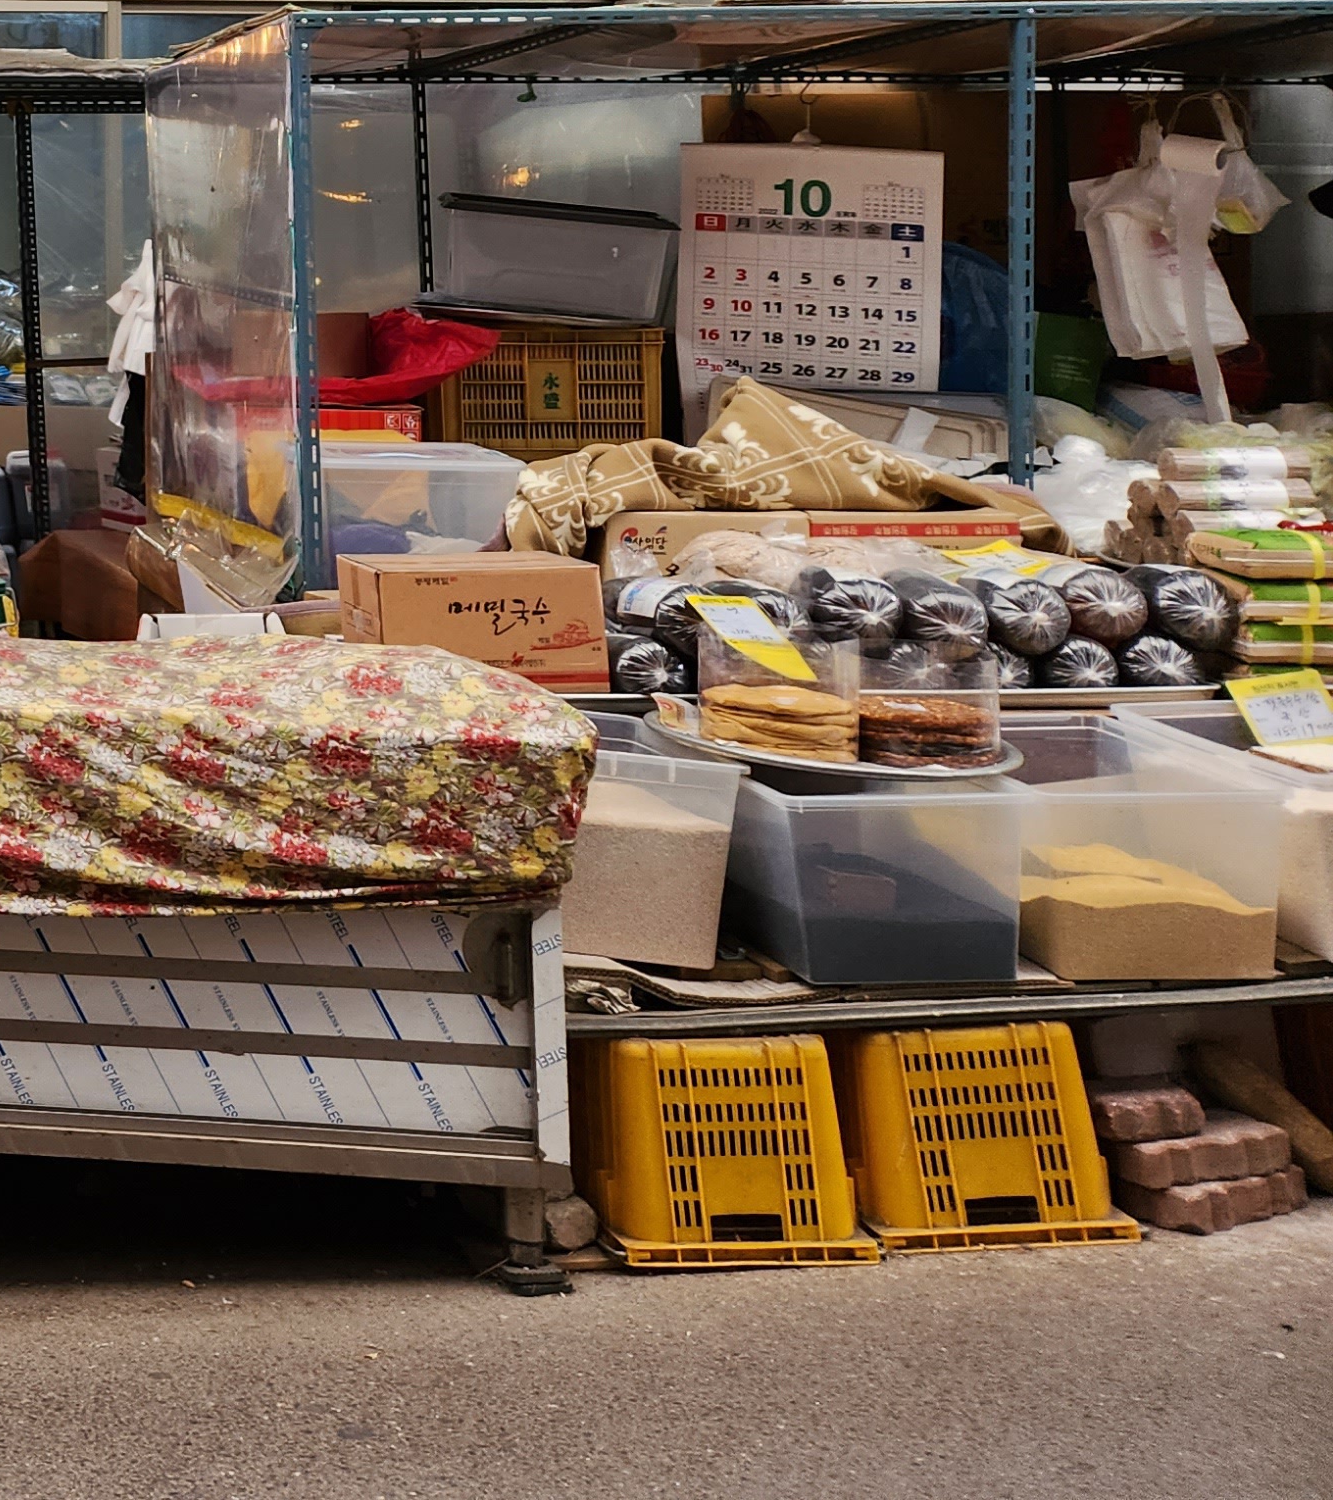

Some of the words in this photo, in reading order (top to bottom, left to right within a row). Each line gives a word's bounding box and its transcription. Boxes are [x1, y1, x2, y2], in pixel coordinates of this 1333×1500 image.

[774, 178, 833, 218] 10
[702, 216, 719, 228] 日
[735, 217, 751, 229] 月
[765, 218, 783, 230] 火
[797, 219, 818, 232] 水
[830, 221, 851, 234] 木
[863, 223, 883, 236] 金
[897, 226, 919, 238] 土
[901, 246, 911, 258] 1
[703, 267, 716, 279] 2
[735, 268, 748, 281] 3
[767, 270, 780, 283] 4
[800, 272, 812, 285] 5
[833, 274, 845, 287] 6
[866, 276, 879, 288] 7
[899, 278, 912, 290] 8
[703, 297, 715, 310] 9
[731, 299, 752, 312] 10
[762, 301, 783, 314] 11
[795, 303, 817, 316] 12
[827, 305, 850, 318] 13
[861, 307, 884, 320] 14
[894, 309, 917, 322] 15
[698, 328, 720, 341] 16
[730, 330, 751, 342] 17
[761, 331, 784, 344] 18
[794, 333, 816, 346] 19
[826, 336, 850, 349] 20
[858, 338, 881, 352] 21
[891, 340, 916, 354] 22
[695, 357, 709, 367] 23
[709, 363, 724, 373] 30
[724, 358, 740, 368] 24
[739, 364, 753, 374] 31
[760, 361, 783, 374] 25
[792, 363, 816, 376] 26
[824, 366, 848, 379] 27
[857, 368, 882, 381] 28
[890, 371, 915, 383] 29
[448, 596, 552, 636] 메밀국수
[326, 911, 350, 941] STEEL
[431, 914, 455, 947] STEEL
